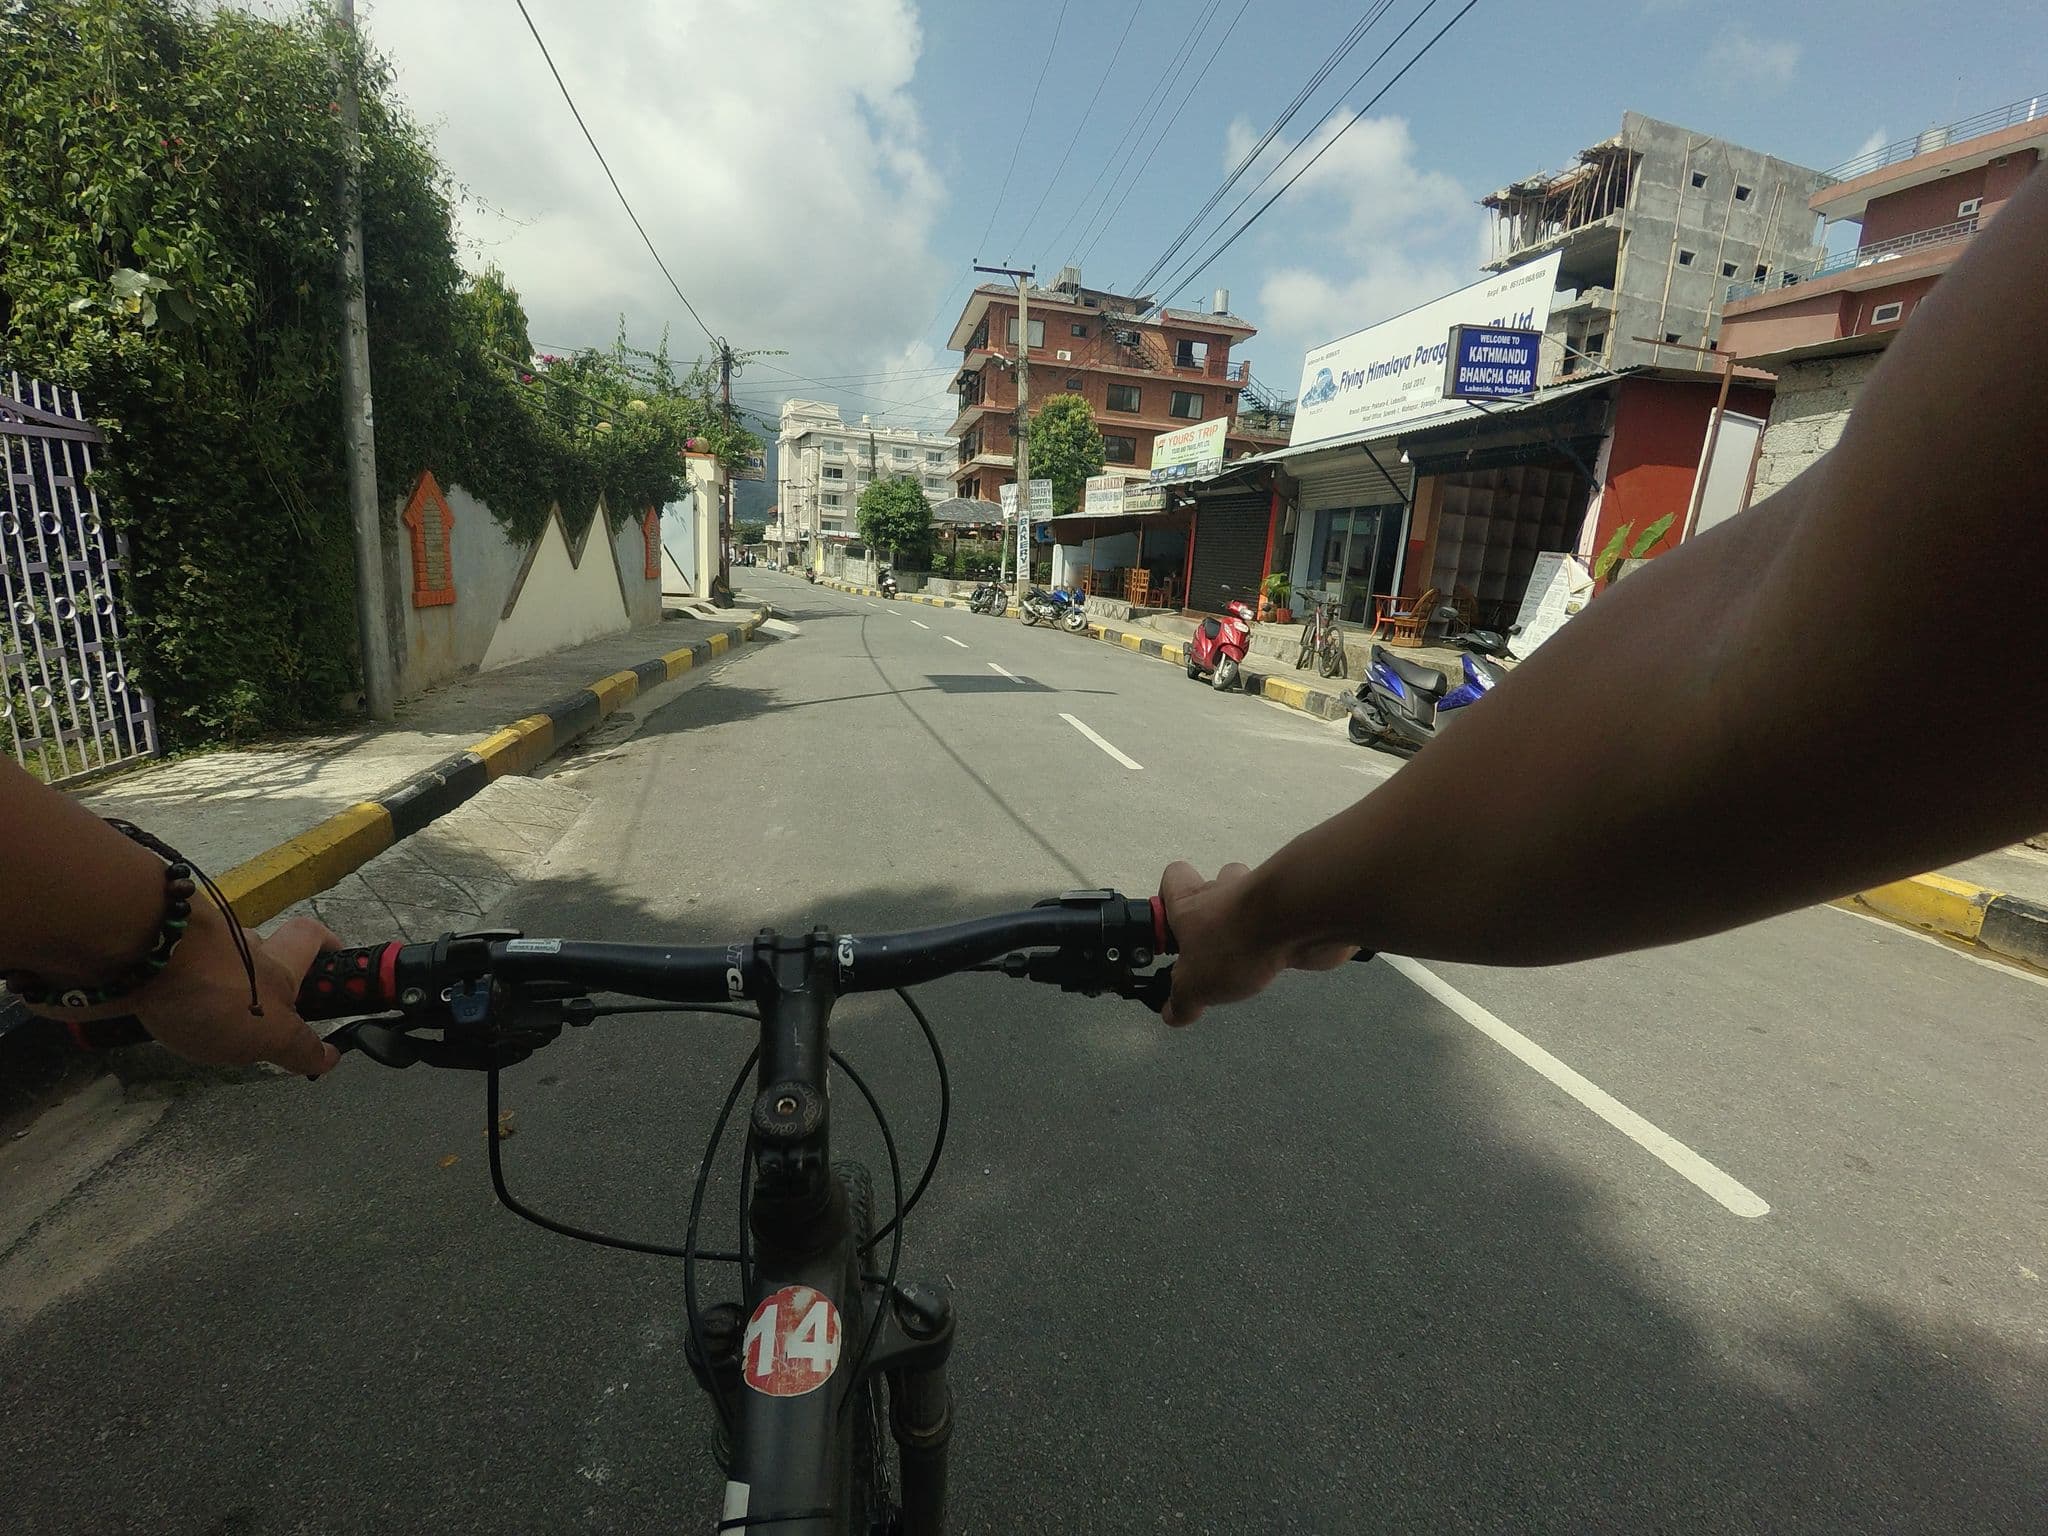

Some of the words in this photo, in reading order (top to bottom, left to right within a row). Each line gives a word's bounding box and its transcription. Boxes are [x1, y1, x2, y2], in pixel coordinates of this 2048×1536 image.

[1480, 334, 1510, 345] WELCOME
[1512, 336, 1520, 345] TO
[1468, 346, 1528, 365] KATHMANDU
[1339, 368, 1365, 392] Flying
[1366, 354, 1412, 384] Himalaya
[1460, 366, 1504, 385] BHANCHA
[1505, 368, 1532, 386] GHAR
[1168, 431, 1195, 446] YOURS
[1198, 424, 1219, 438] TRIP
[1030, 488, 1051, 498] BAKERY
[1020, 518, 1028, 564] BAKERY
[745, 1300, 837, 1376] 14
